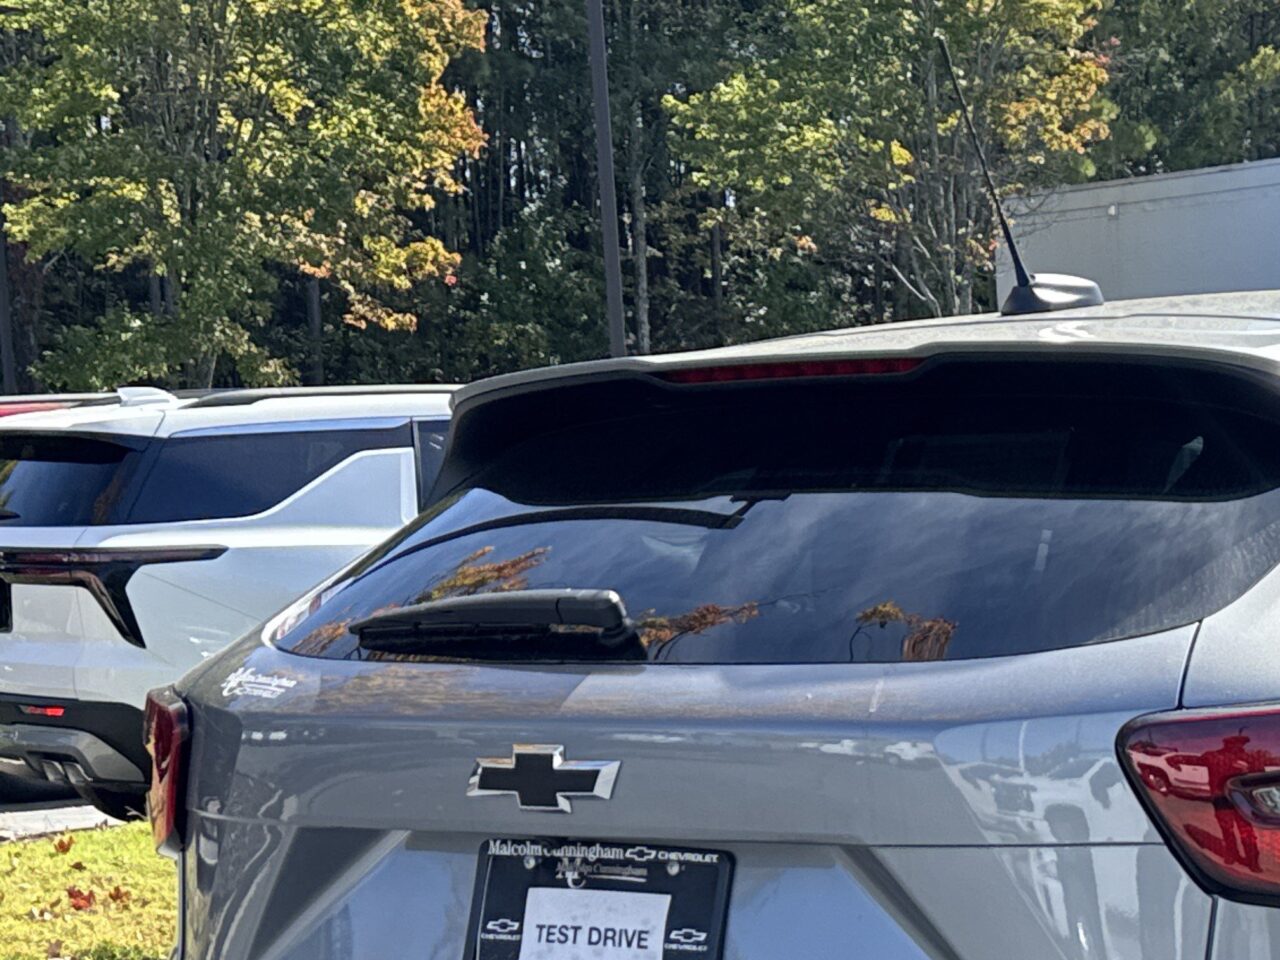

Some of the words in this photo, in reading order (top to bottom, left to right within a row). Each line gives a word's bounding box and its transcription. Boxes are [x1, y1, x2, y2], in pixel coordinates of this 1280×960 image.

[487, 839, 542, 857] Malcolm
[658, 850, 719, 863] CHEVROLET
[536, 924, 582, 945] TEST
[588, 926, 650, 950] DRIVE
